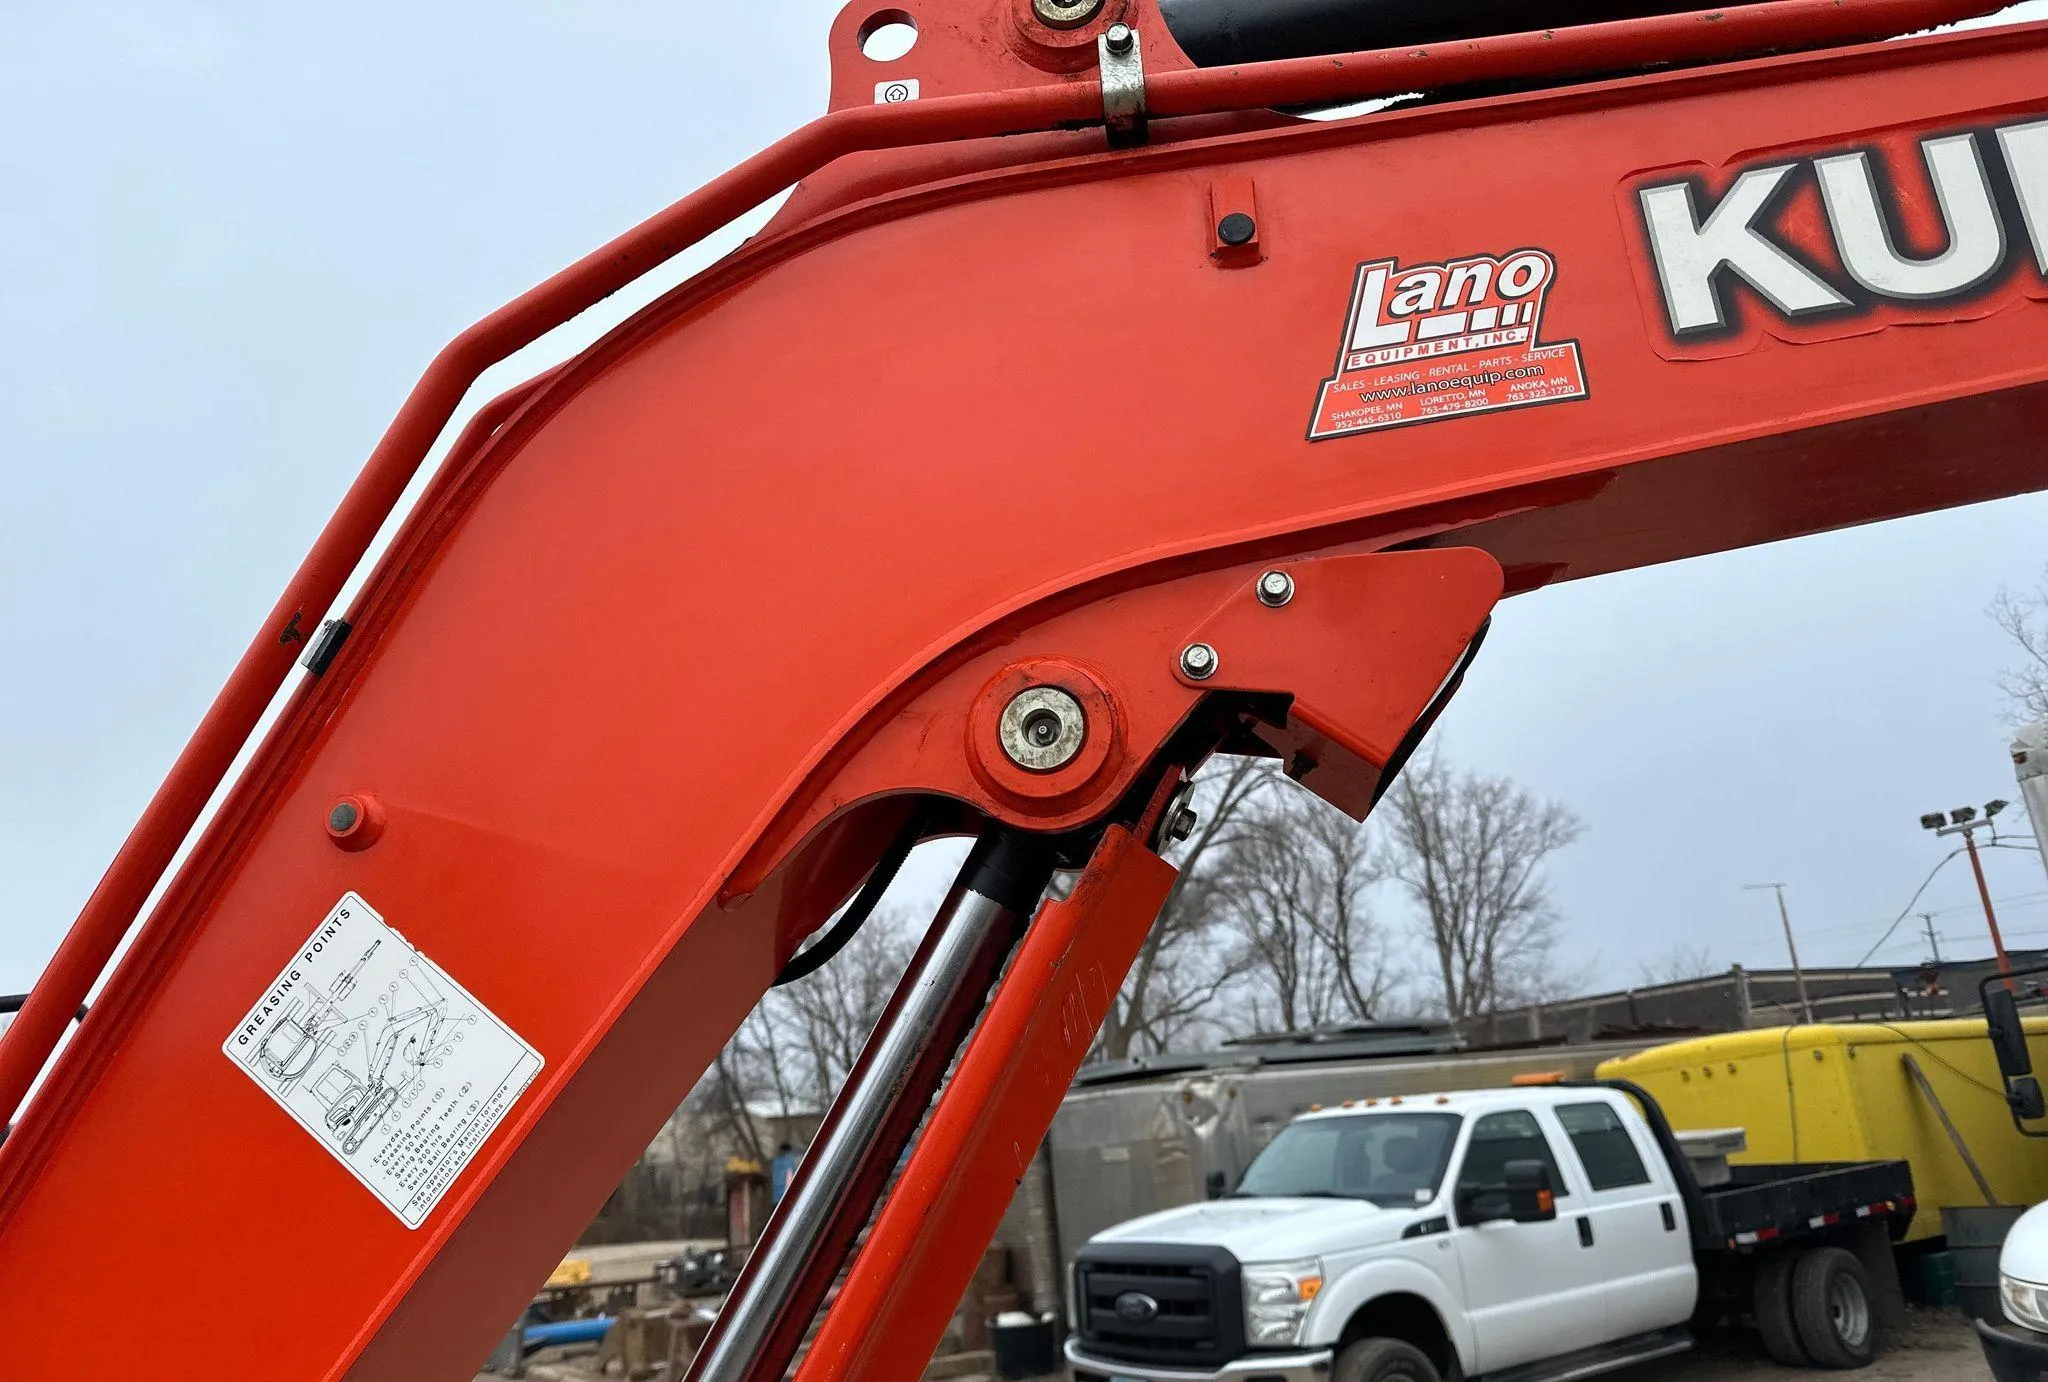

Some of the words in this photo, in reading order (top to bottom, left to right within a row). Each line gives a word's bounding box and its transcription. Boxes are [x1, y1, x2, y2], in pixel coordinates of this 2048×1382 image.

[1351, 255, 1546, 351] Lano
[1333, 379, 1365, 393] SALES
[1374, 371, 1420, 386] LEASING
[1429, 363, 1469, 377] RENTAL
[1479, 355, 1512, 369] PARTS
[1521, 348, 1566, 363] SERVICE
[1359, 364, 1545, 403] www.lanoequip.com
[1507, 385, 1575, 402] 763-323-1720
[1510, 380, 1549, 392] ANOKA,
[1550, 376, 1568, 386] MN
[1331, 406, 1384, 421] SHAKOPEE,
[1386, 402, 1403, 412] MN
[1335, 411, 1402, 430] 952-445-6310
[1420, 392, 1466, 406] LORETTO,
[1469, 389, 1486, 399] MN
[1421, 398, 1489, 415] 763-479-8200
[238, 970, 301, 1045] GREASING
[304, 909, 350, 962] POINTS
[373, 1129, 402, 1163] Everyday
[382, 1133, 411, 1166] Greasing
[410, 1106, 431, 1130] Points
[386, 1153, 405, 1175] Every
[405, 1141, 414, 1151] 50
[414, 1128, 426, 1140] hrs
[395, 1156, 415, 1179] Swing
[414, 1124, 440, 1154] Bearing
[439, 1100, 458, 1121] Teeth
[408, 1168, 428, 1191] Swing
[427, 1150, 441, 1166] Ball
[441, 1119, 467, 1148] Bearing
[412, 1192, 425, 1206] See
[426, 1150, 458, 1189] operator's
[458, 1118, 481, 1147] Manual
[481, 1106, 491, 1118] for
[492, 1086, 508, 1104] more
[417, 1168, 453, 1212] information
[454, 1150, 466, 1166] and
[466, 1104, 503, 1149] instructions
[399, 1166, 418, 1187] Every
[418, 1149, 430, 1164] 200
[430, 1135, 442, 1147] hrs
